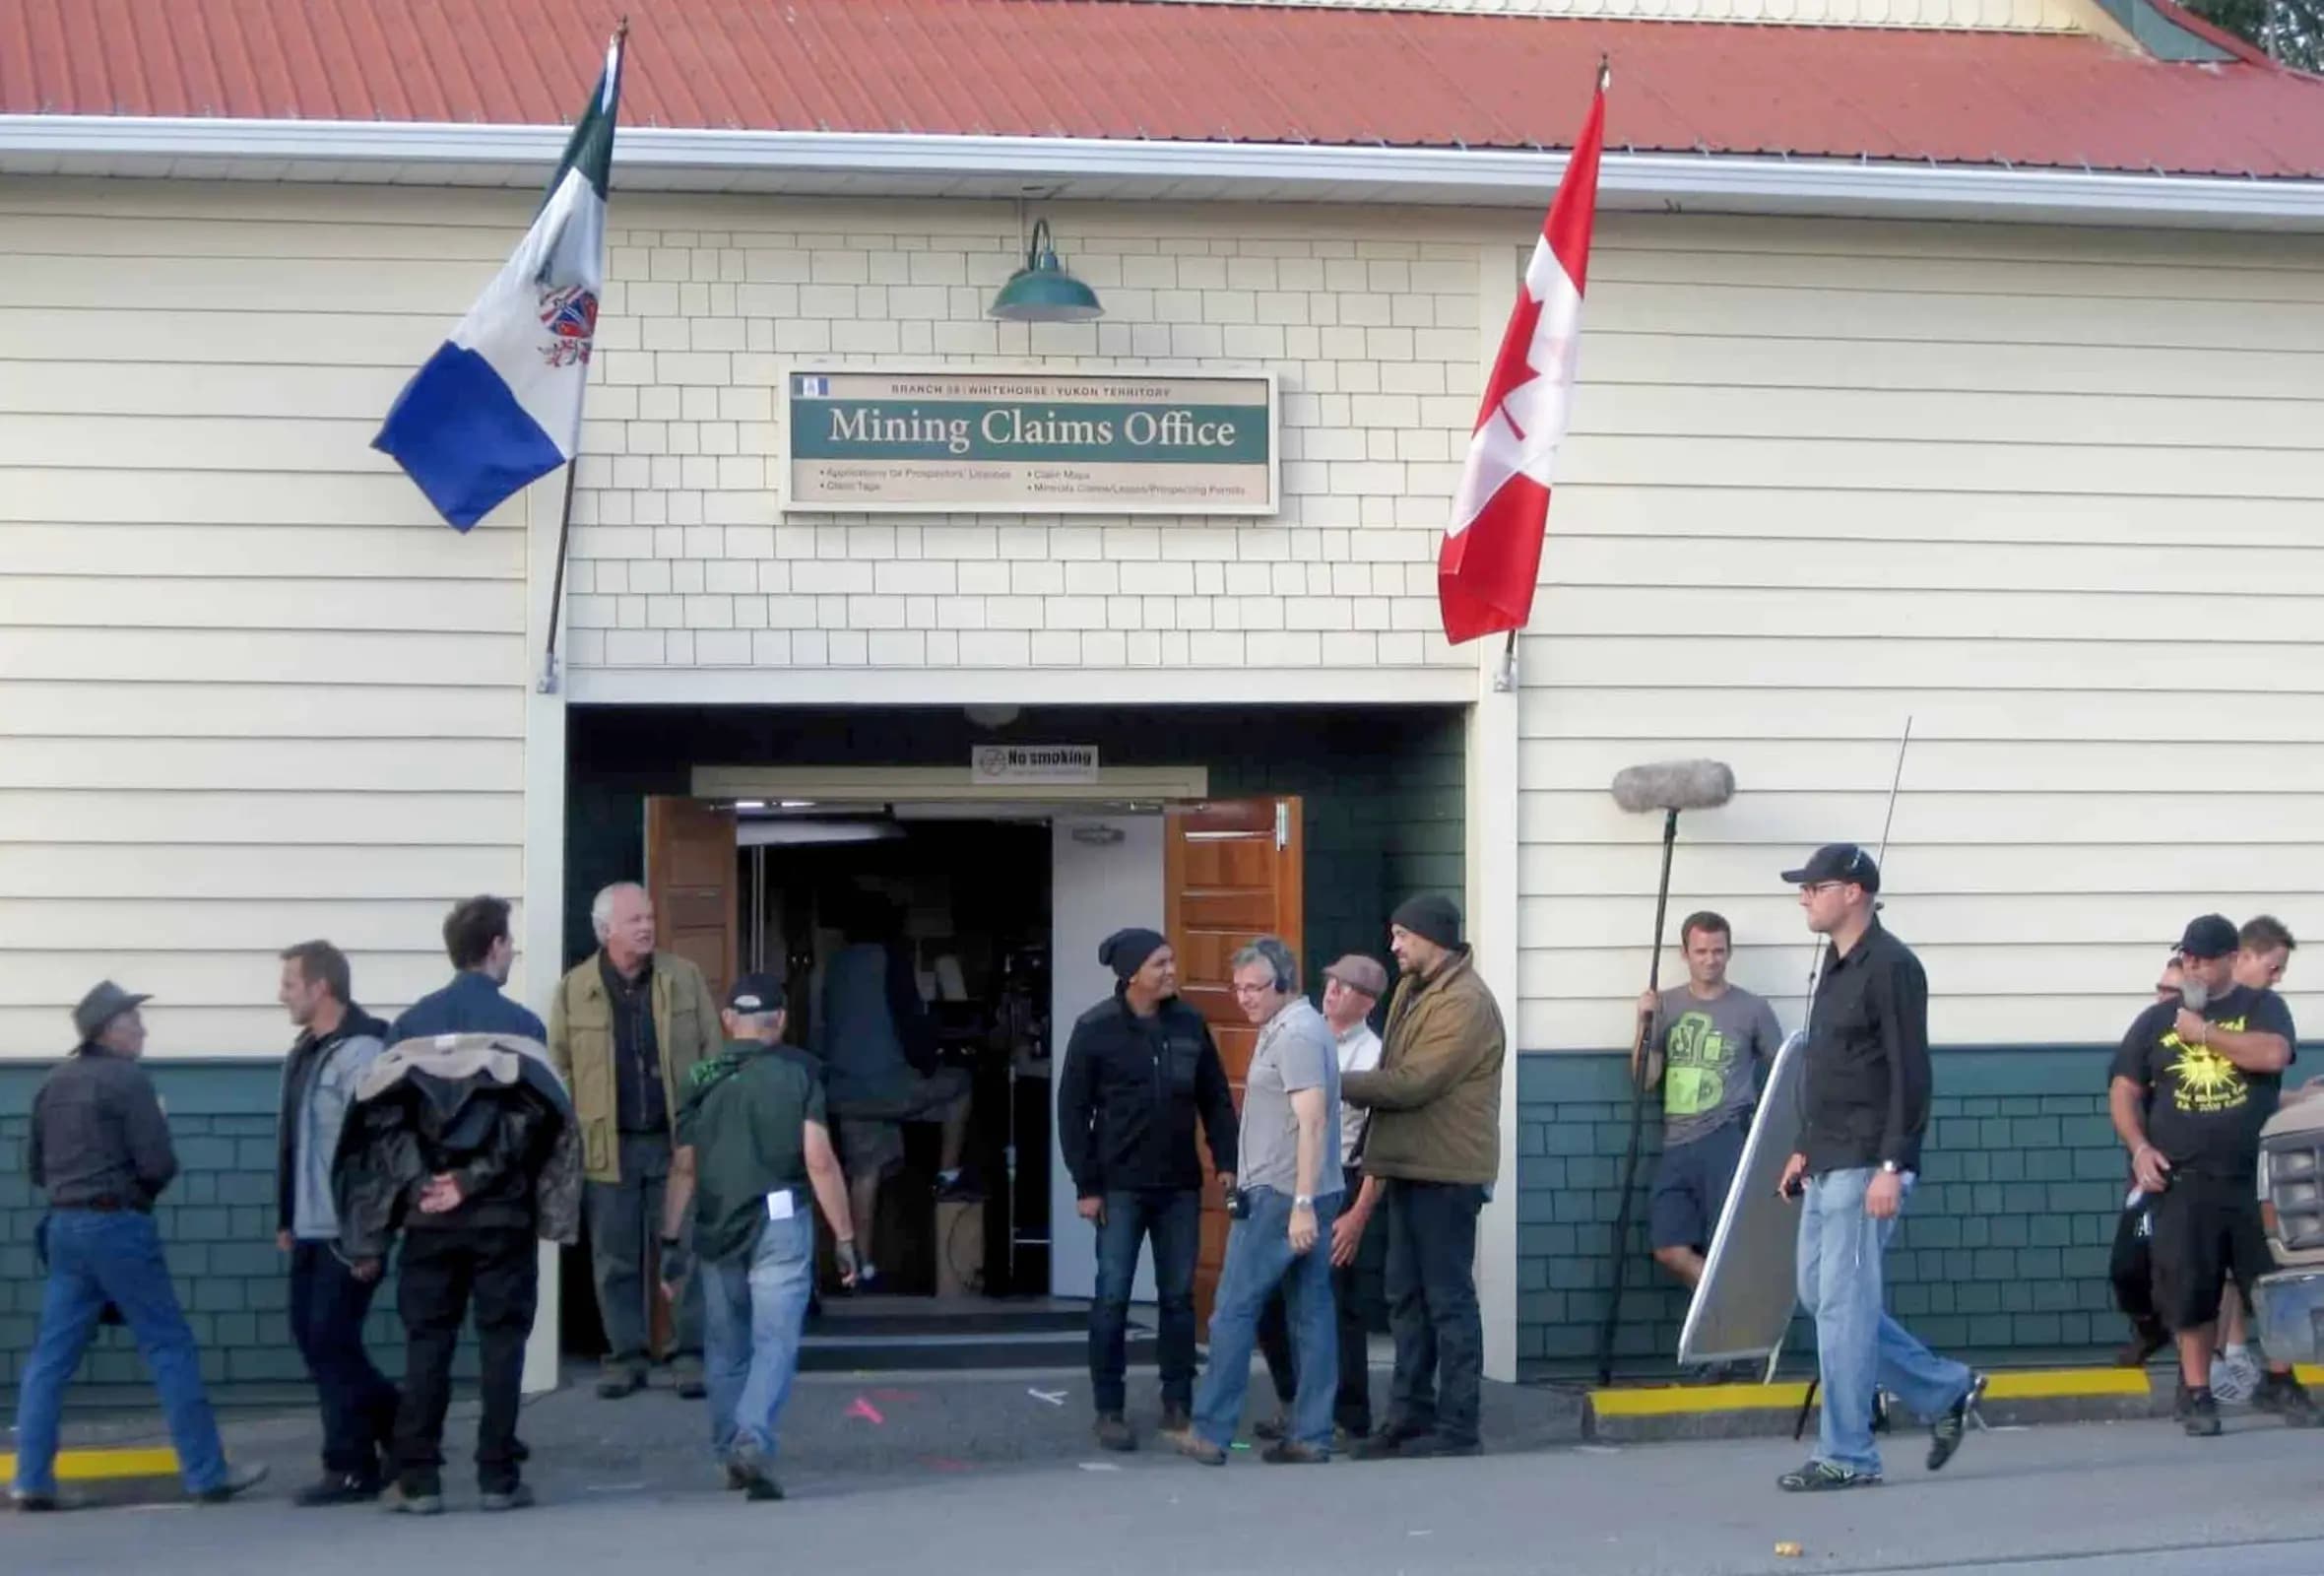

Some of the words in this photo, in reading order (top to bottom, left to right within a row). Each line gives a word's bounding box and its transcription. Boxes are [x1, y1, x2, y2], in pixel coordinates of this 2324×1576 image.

[969, 384, 1047, 396] WHITEHORSE
[1058, 385, 1099, 397] YUKON
[1103, 386, 1172, 398] TERRITORY
[828, 407, 971, 454] Mining
[982, 408, 1114, 445] Claims
[1124, 411, 1237, 446] Office
[1007, 749, 1027, 765] No
[1029, 749, 1092, 767] smoking
